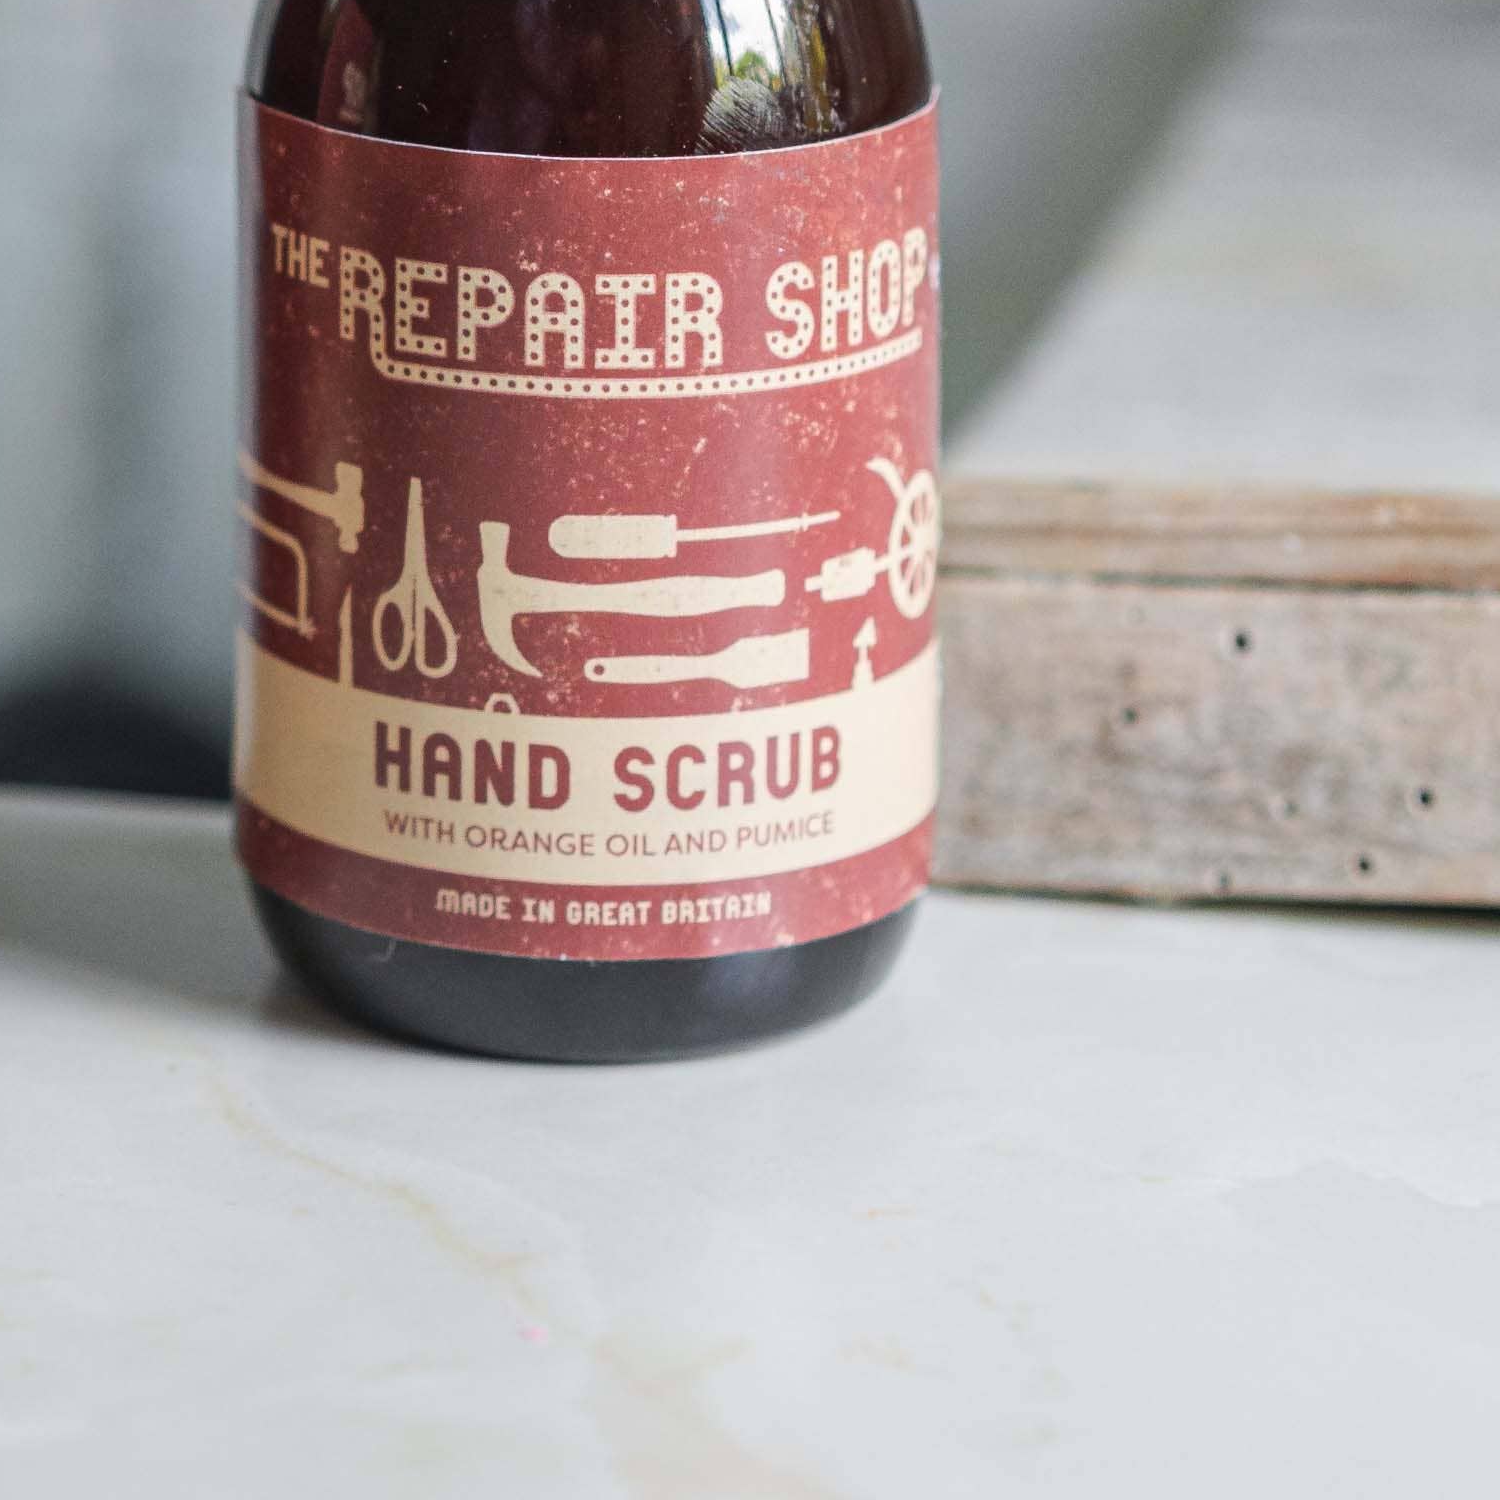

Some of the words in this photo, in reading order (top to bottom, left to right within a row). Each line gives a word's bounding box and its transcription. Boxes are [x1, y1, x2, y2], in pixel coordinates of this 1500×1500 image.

[271, 223, 329, 290] THE
[339, 246, 724, 370] REPAIR
[765, 226, 928, 360] SHOP
[374, 721, 571, 811] HAND
[614, 725, 841, 812] SCRUB
[383, 811, 455, 845] WITH
[465, 821, 595, 856] ORANGE
[606, 834, 657, 857] OIL
[664, 829, 727, 855] AND
[736, 811, 835, 850] PUMICE
[436, 888, 511, 921] MADE
[522, 897, 554, 924] IN
[567, 901, 648, 926] GREAT
[662, 891, 772, 924] BRITAIN
